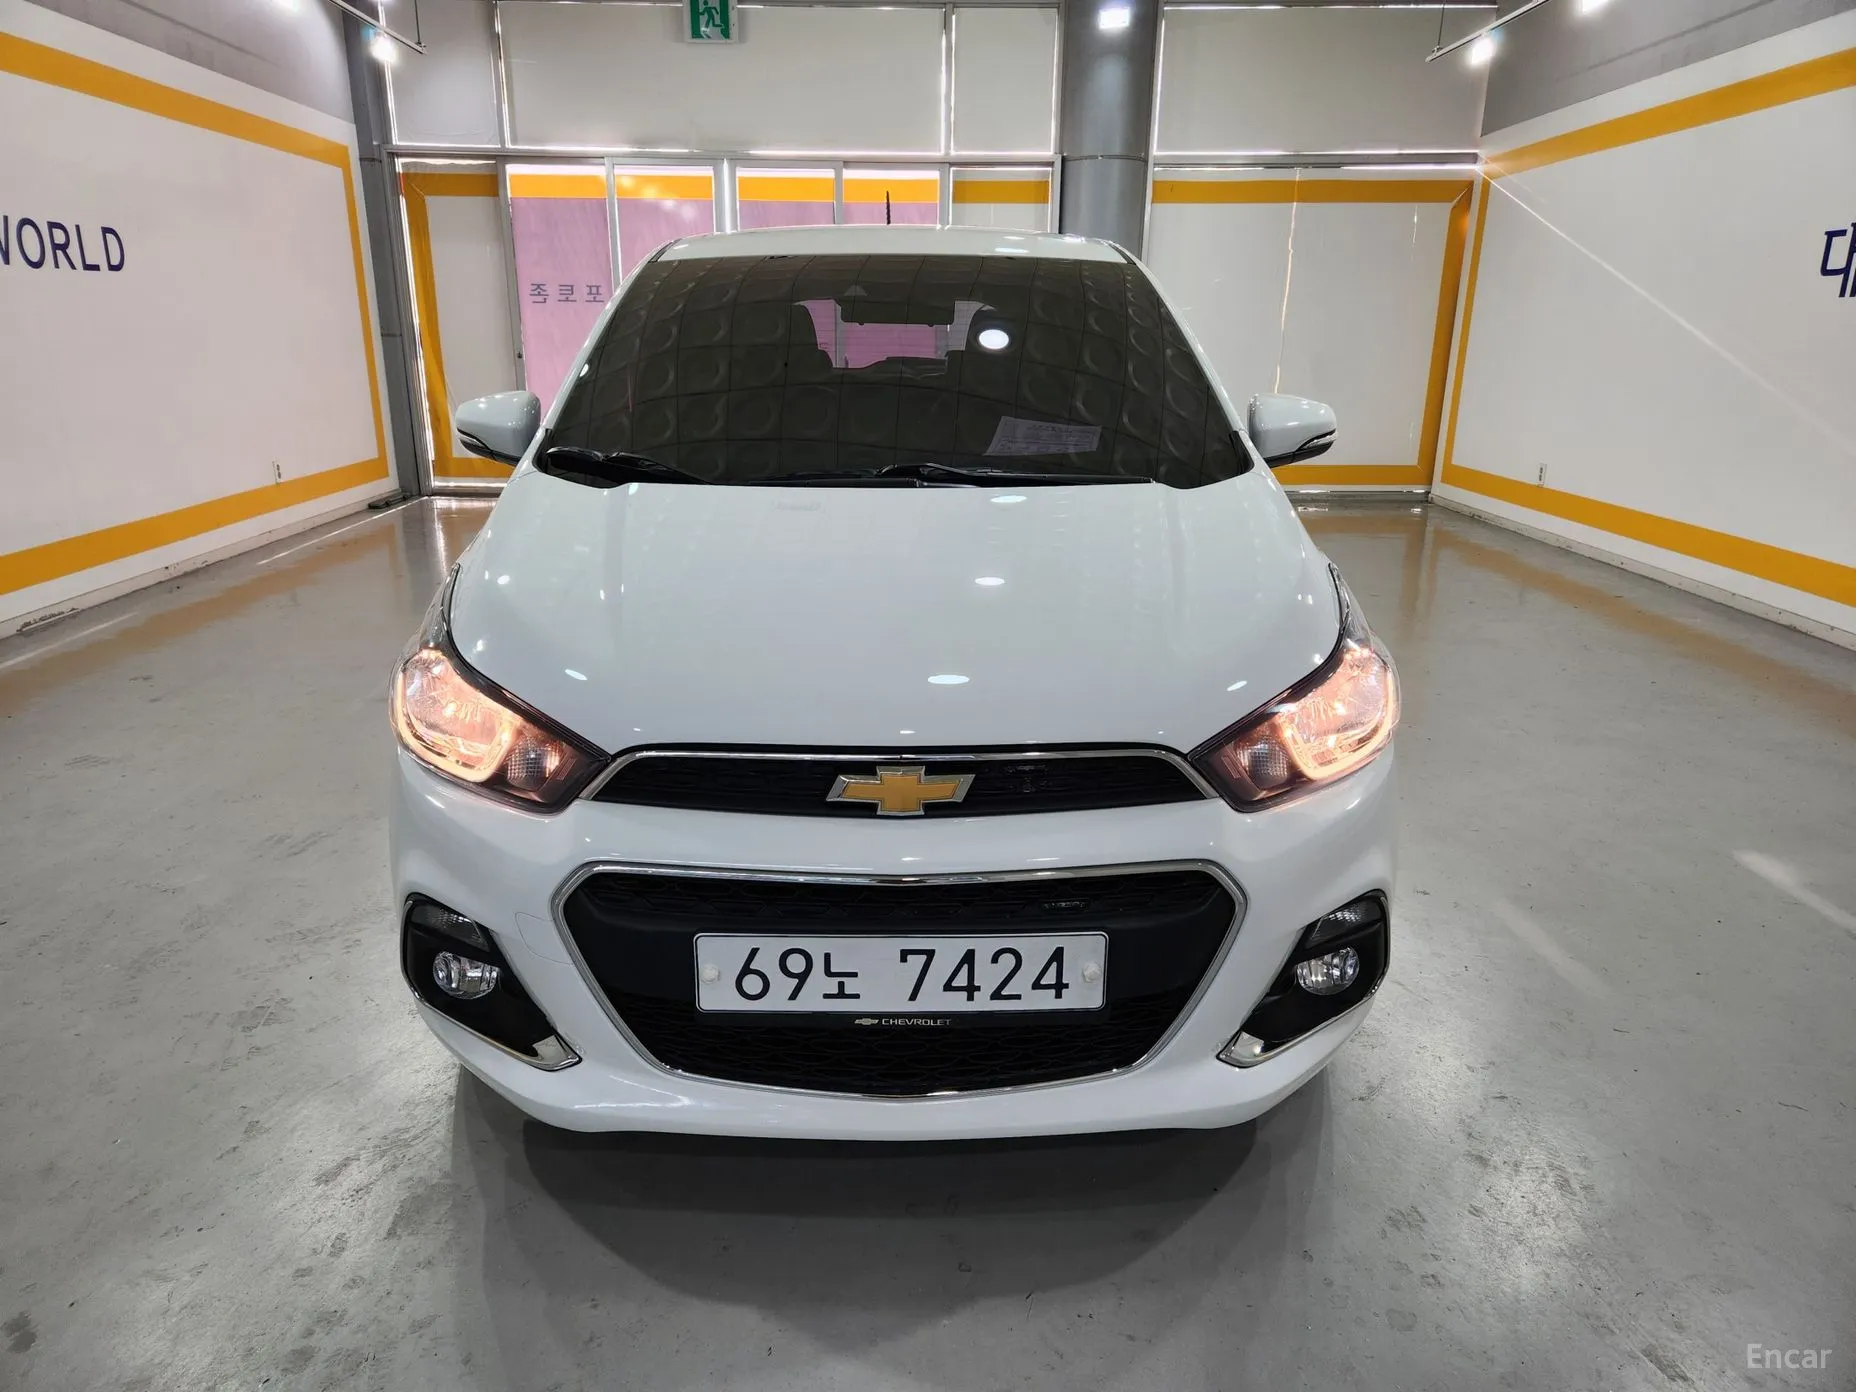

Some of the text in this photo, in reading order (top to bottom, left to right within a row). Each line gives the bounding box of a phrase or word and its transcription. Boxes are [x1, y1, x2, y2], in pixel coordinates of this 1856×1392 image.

[735, 946, 1070, 1002] 69노 7424
[881, 1018, 952, 1026] CHEVROLET
